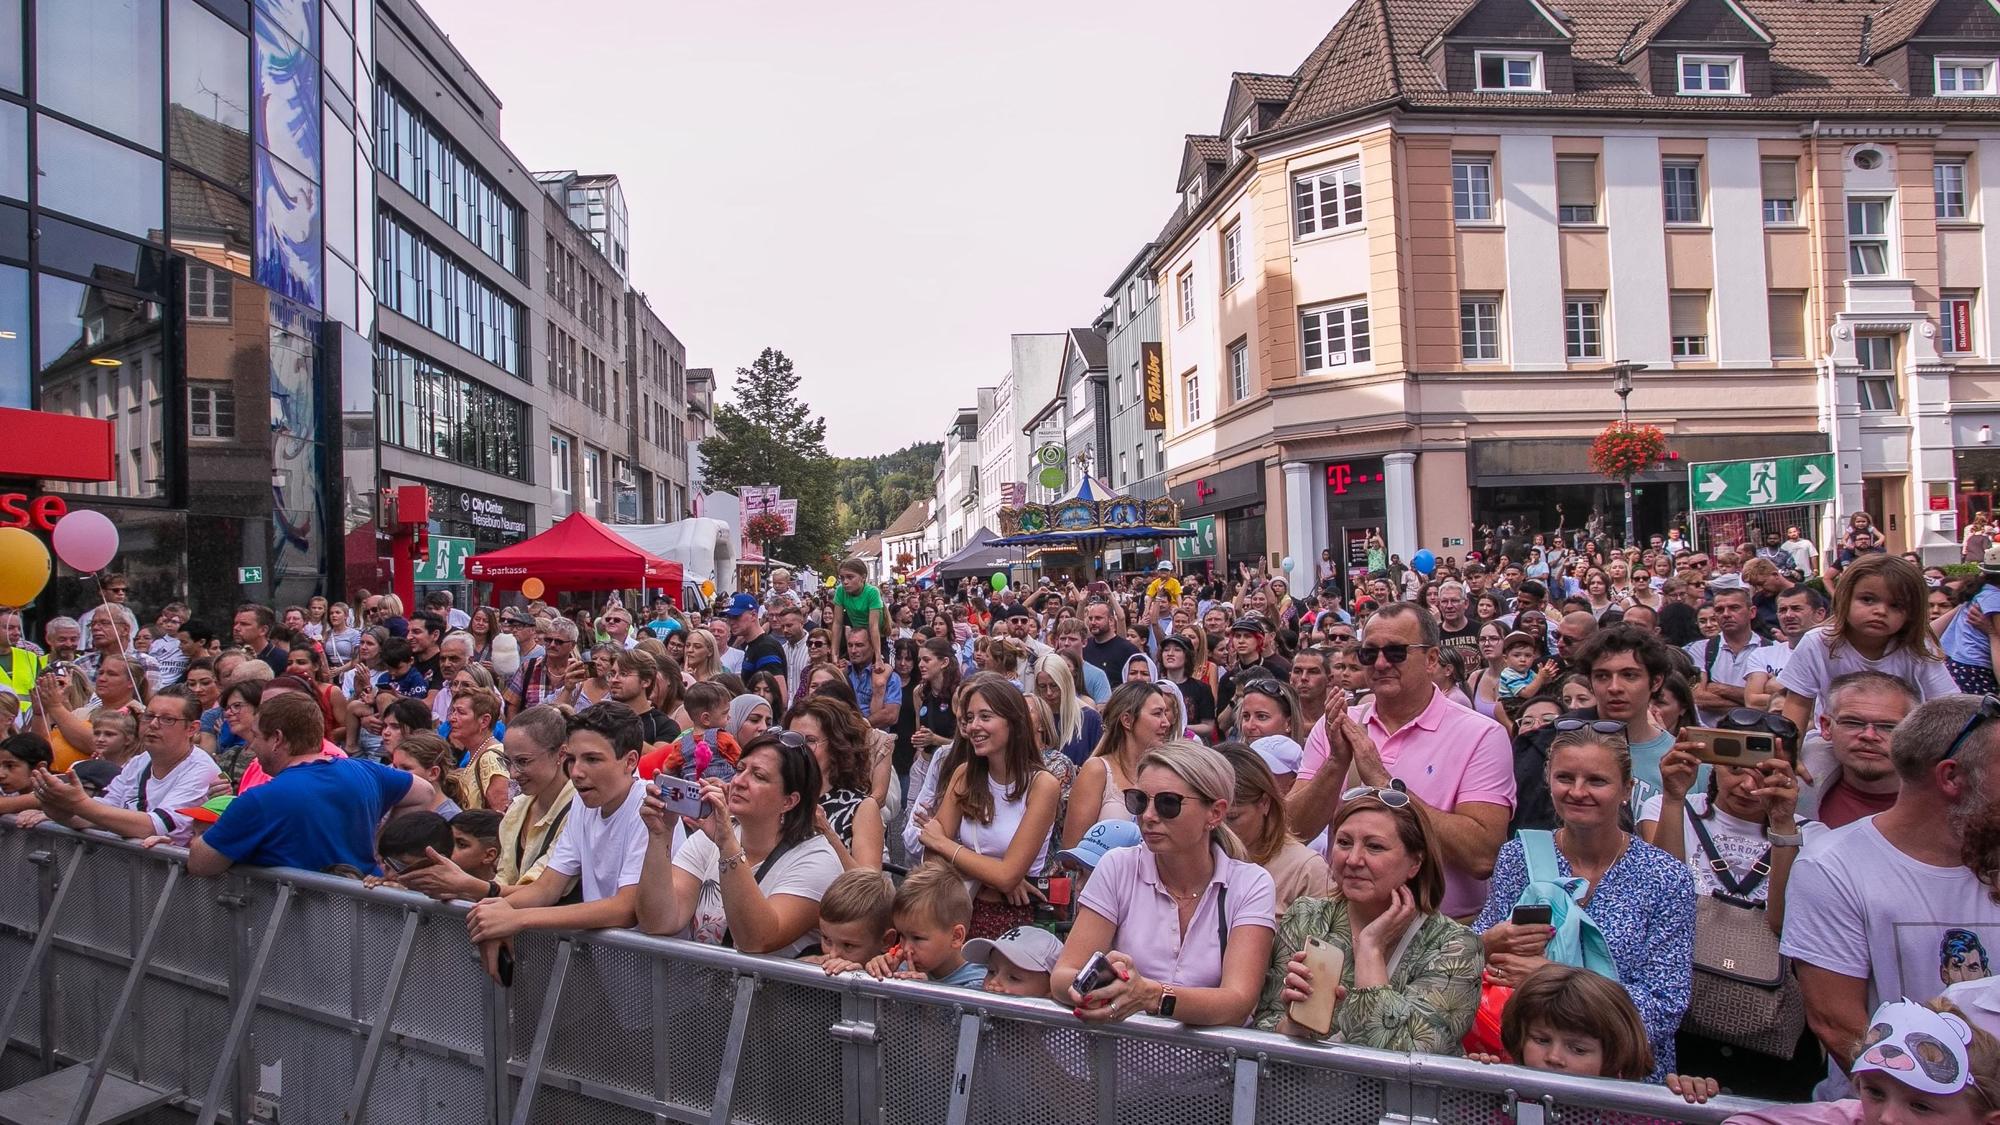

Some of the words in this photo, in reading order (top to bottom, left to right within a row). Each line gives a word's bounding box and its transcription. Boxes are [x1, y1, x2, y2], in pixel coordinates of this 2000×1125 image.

[1147, 349, 1162, 403] Tchibo
[472, 497, 485, 515] City
[485, 500, 503, 515] Center
[472, 511, 501, 529] Reisebüro
[501, 517, 526, 533] Naumann
[486, 566, 528, 576] Sparkasse
